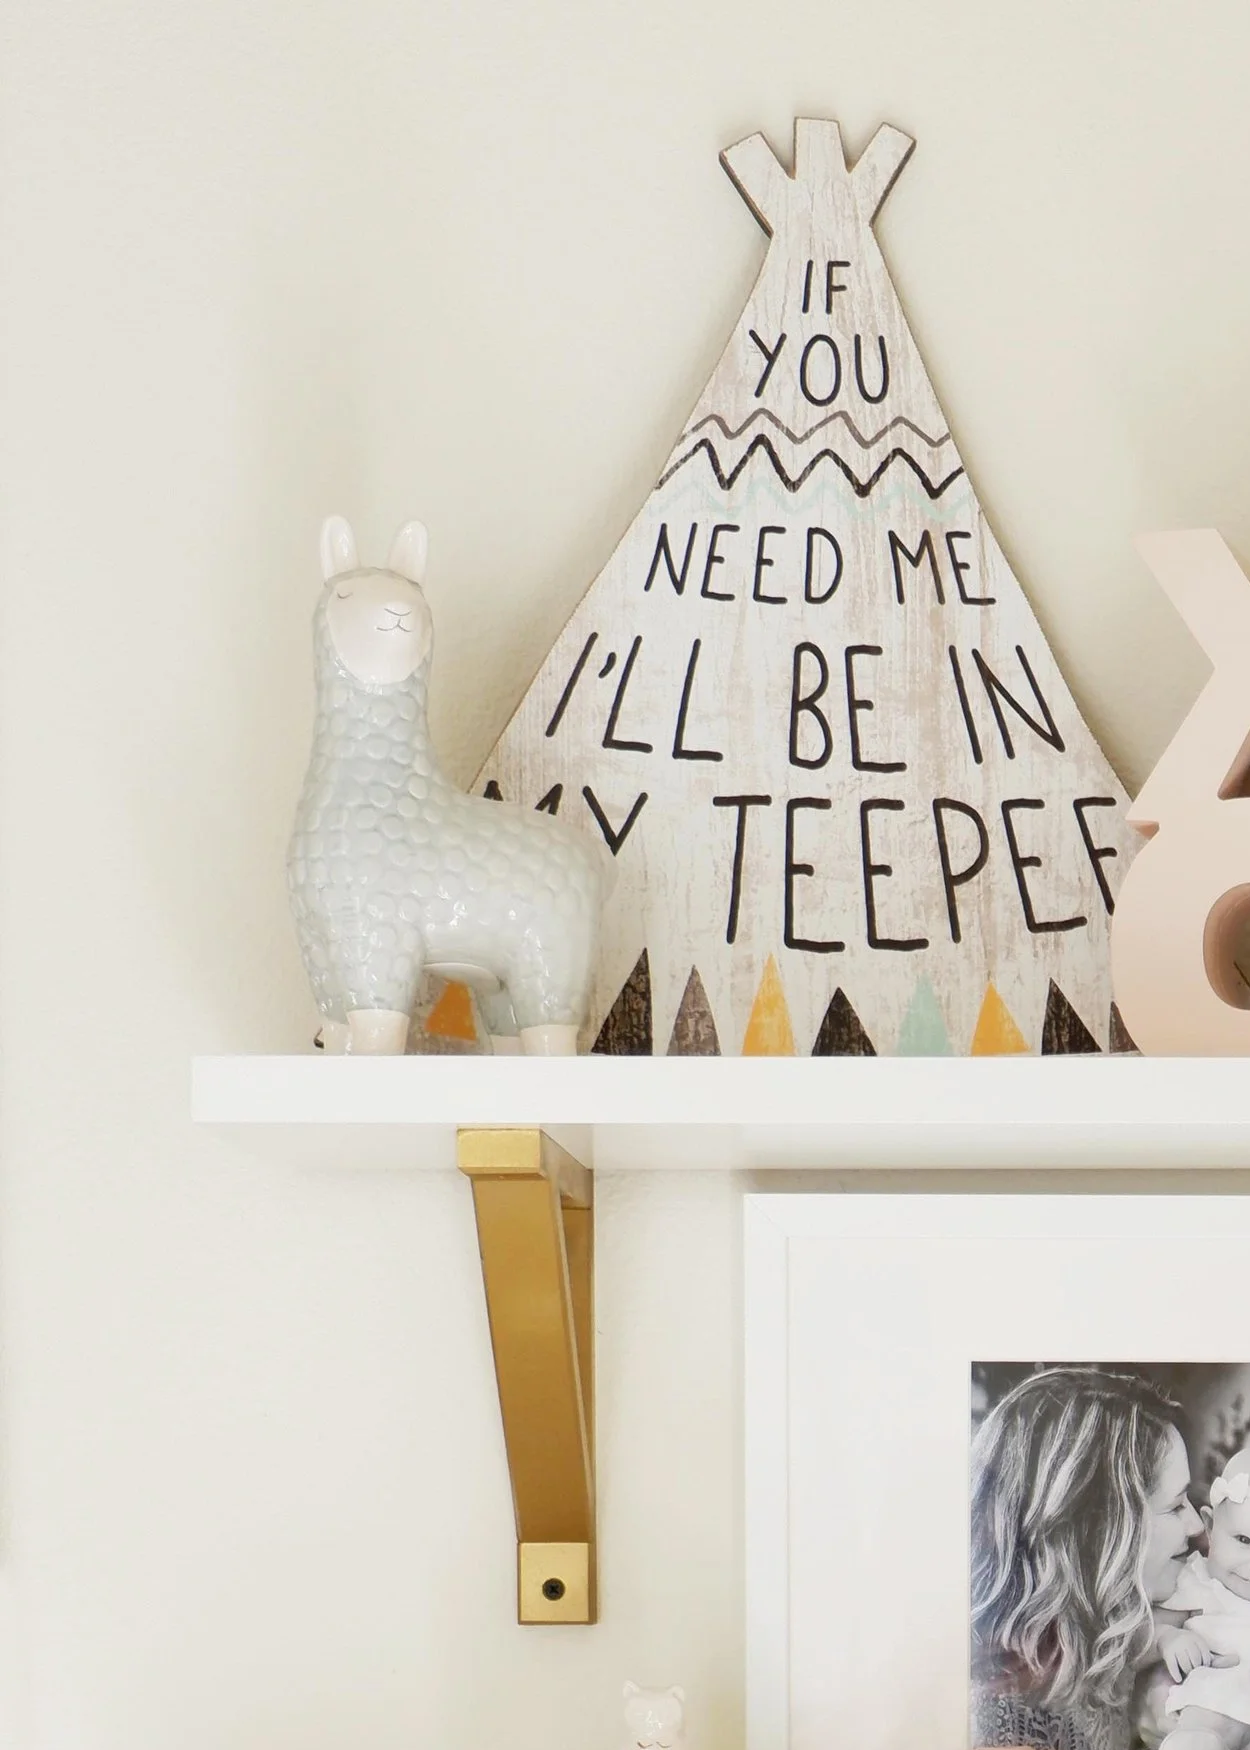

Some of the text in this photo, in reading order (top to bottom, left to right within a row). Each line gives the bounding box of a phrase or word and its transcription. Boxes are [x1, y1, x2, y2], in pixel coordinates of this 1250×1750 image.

[801, 261, 852, 315] IF
[748, 328, 892, 407] YOU
[644, 522, 996, 606] NEED ME
[545, 632, 1066, 773] I'LL BE IN
